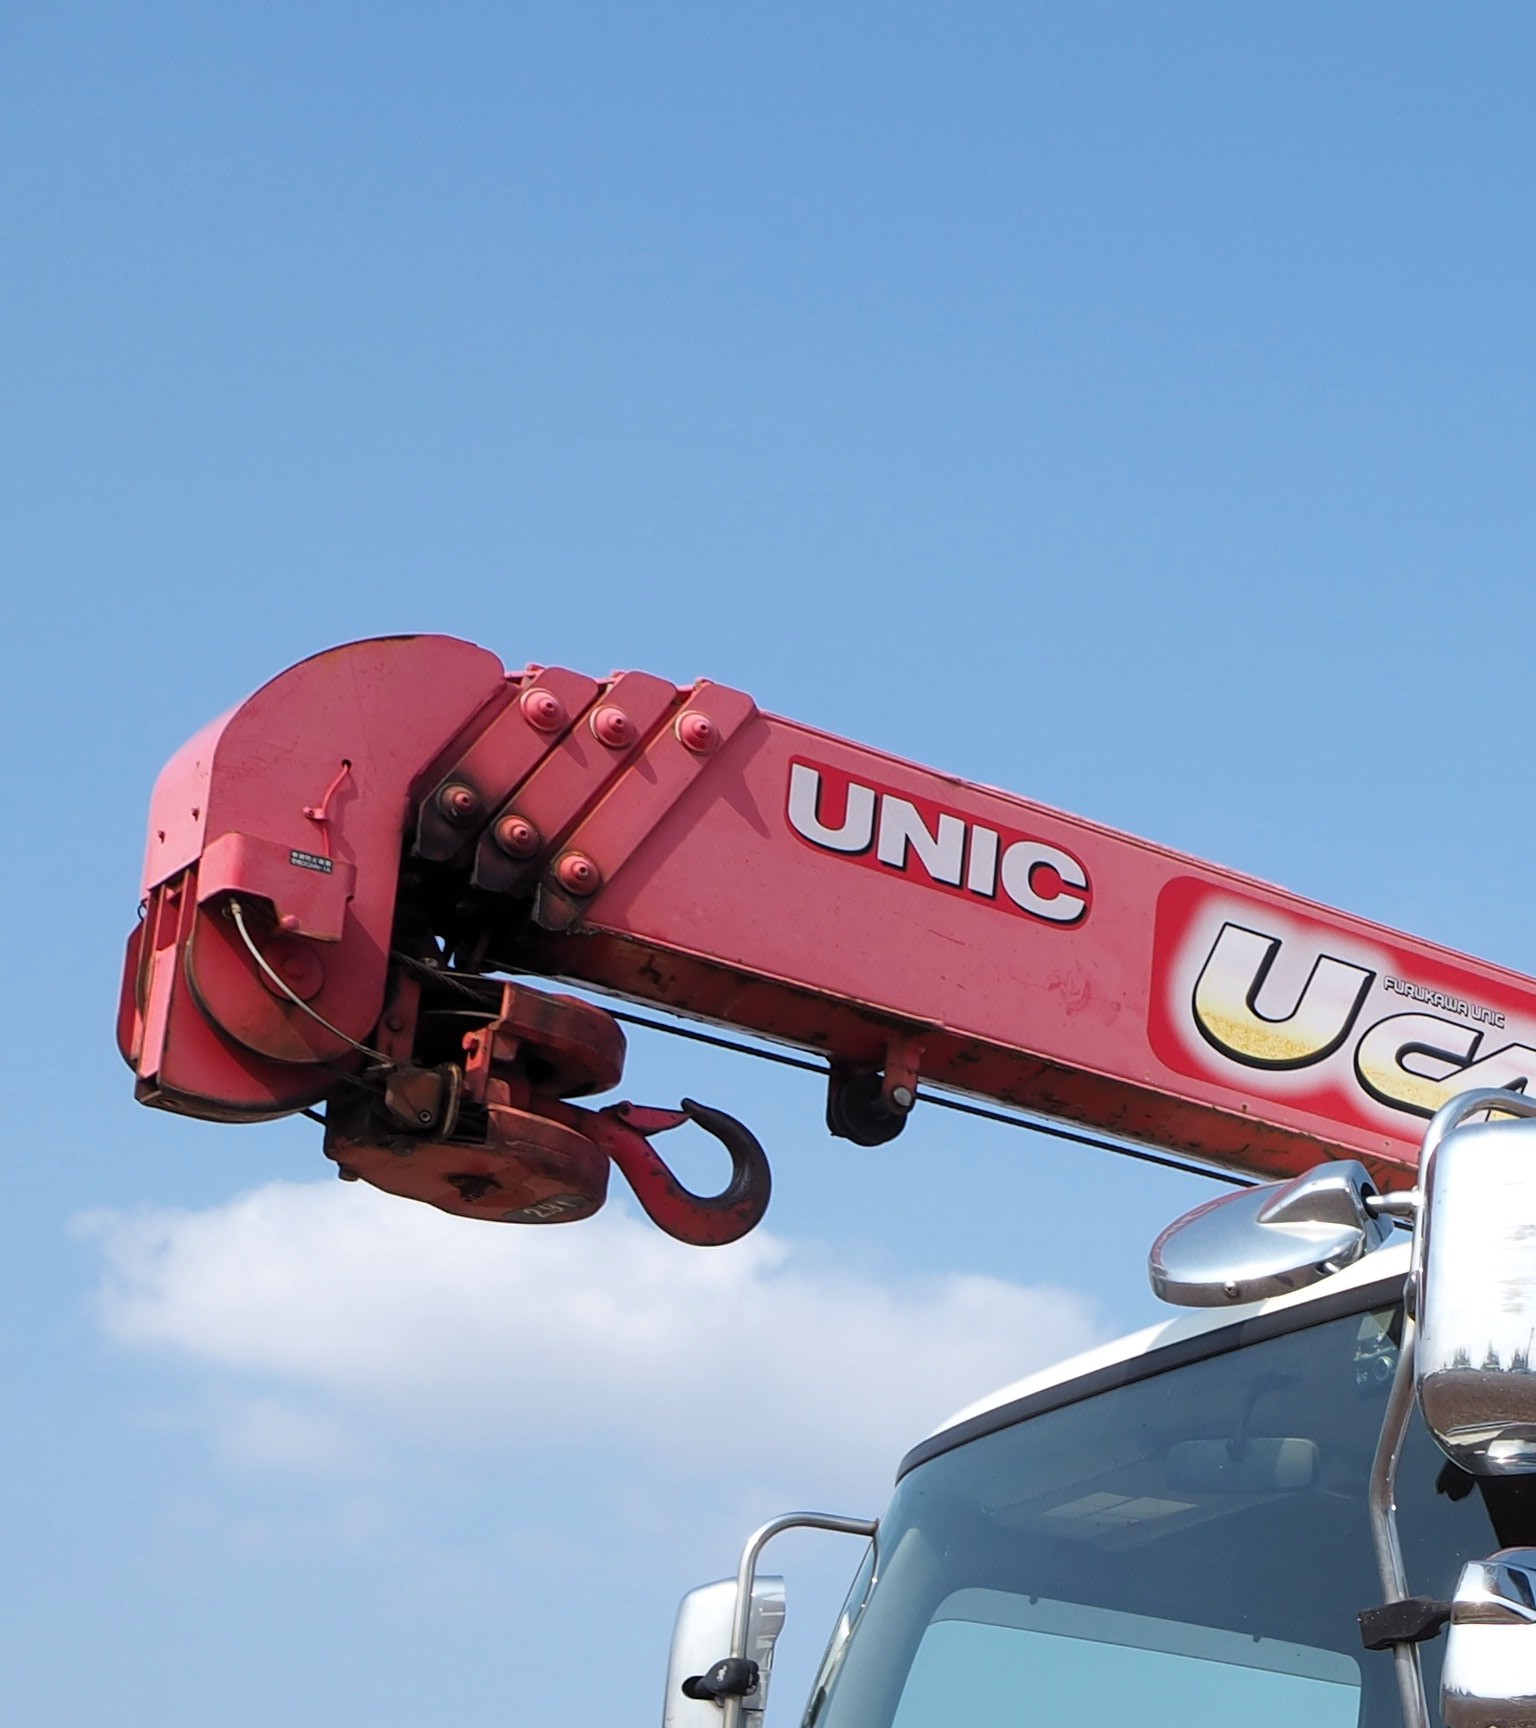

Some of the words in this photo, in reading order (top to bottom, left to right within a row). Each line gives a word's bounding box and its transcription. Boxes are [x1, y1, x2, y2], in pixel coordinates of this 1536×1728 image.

[787, 762, 1091, 925] UNIC
[1383, 975, 1469, 1017] FURUKAWA
[1470, 1004, 1506, 1029] UNIC
